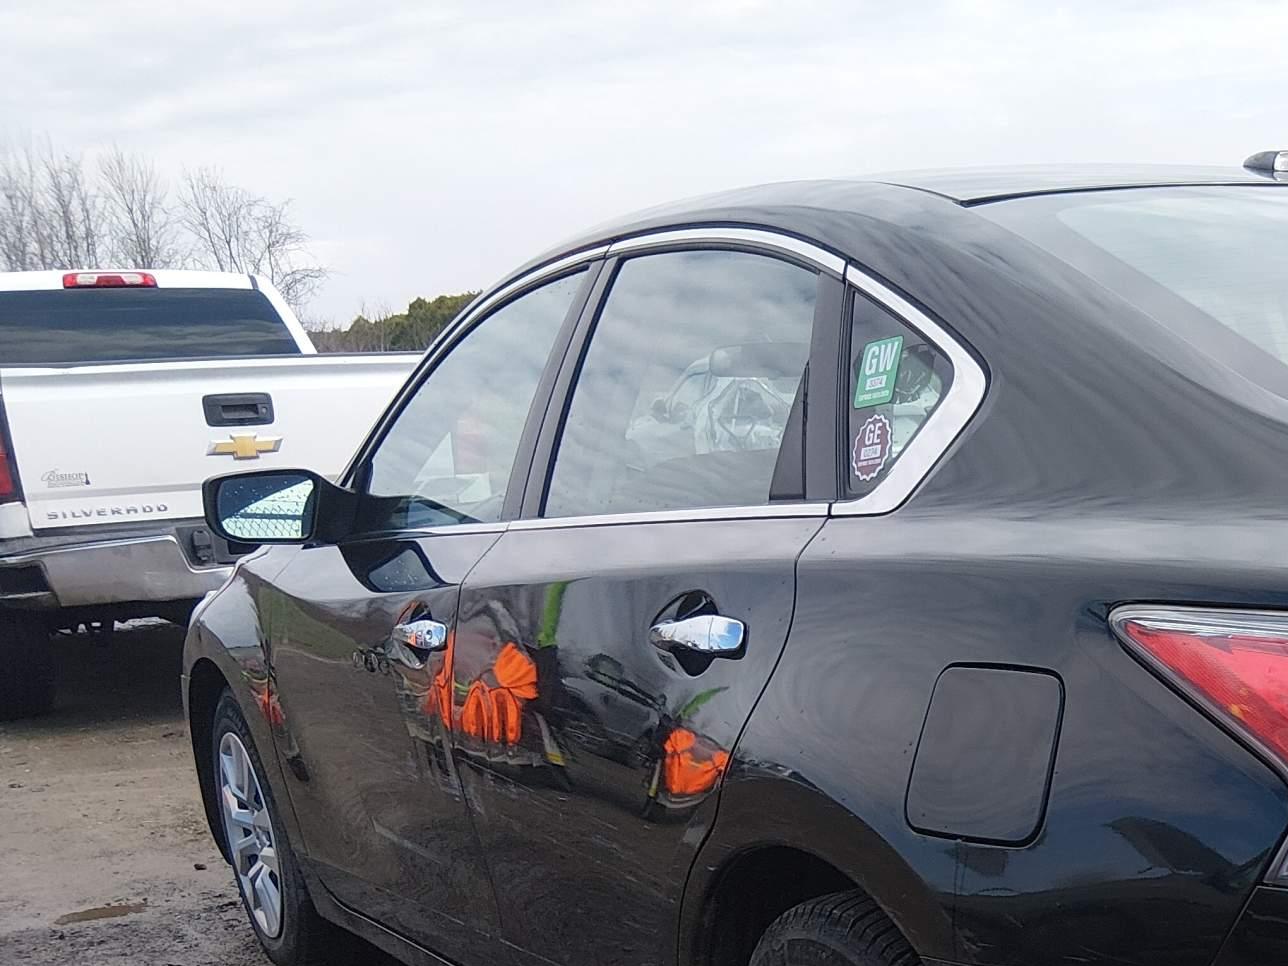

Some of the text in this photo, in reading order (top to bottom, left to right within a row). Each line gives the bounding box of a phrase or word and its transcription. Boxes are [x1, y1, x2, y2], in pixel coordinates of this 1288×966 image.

[865, 341, 899, 375] GW
[865, 422, 883, 445] GE
[47, 504, 168, 520] SILVERADO
